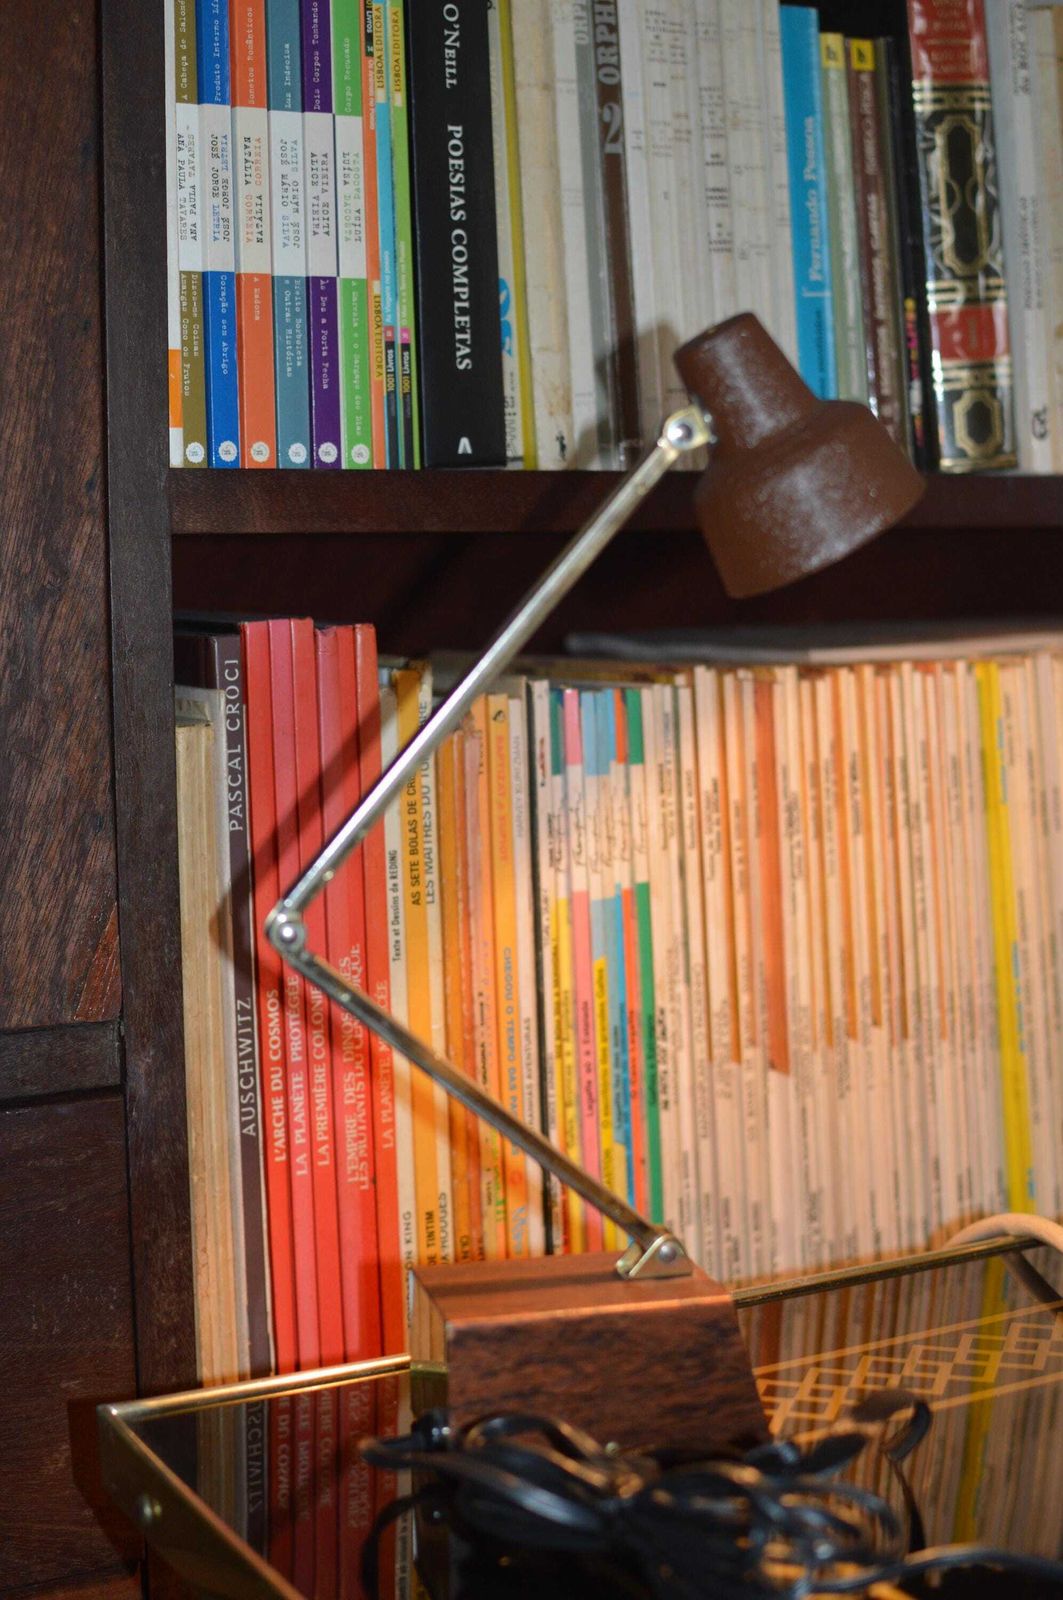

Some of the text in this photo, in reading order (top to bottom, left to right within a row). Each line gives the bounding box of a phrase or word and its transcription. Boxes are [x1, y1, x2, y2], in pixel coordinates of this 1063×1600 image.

[179, 37, 188, 51] de
[365, 10, 374, 33] Livros
[375, 6, 385, 89] LISBOA EDITORA
[392, 10, 402, 93] LISBOA EDITORA
[213, 19, 222, 103] Produto Interno
[594, 0, 623, 154] 2 ORPH
[177, 132, 188, 241] ANA PAULA TAVARES
[187, 133, 196, 178] TAVARES
[342, 151, 353, 186] LUÍSA
[446, 124, 467, 221] POESIAS
[189, 184, 197, 216] PAULA
[210, 133, 221, 242] JOSÉ JORGE LETRIA
[221, 134, 230, 242] JOSÉ JORGE LETRIA
[244, 135, 255, 243] NATÁLIA CORREIA
[253, 136, 264, 243] NATÁLIA CORREIA
[280, 138, 291, 249] JOSÉ MÁRIO SILVA
[291, 179, 301, 214] MÁRIO
[310, 151, 321, 237] ALICE VIEIRA
[321, 152, 330, 237] ALICE VIEIRA
[291, 221, 301, 249] JOSÉ
[219, 274, 229, 314] Coração
[451, 228, 473, 370] COMPLETAS
[181, 318, 191, 341] Como
[221, 340, 230, 375] Abrigo
[321, 329, 329, 357] Porta
[373, 294, 383, 378] LISBOA EDITORA
[385, 349, 395, 392] 1001 Livros
[402, 351, 411, 393] 1001 Livros
[224, 659, 243, 832] PASCAL CROCI
[407, 799, 417, 815] DE
[421, 785, 431, 806] DU
[408, 818, 419, 856] BOLAS
[409, 860, 420, 887] SETE
[411, 891, 421, 906] AS
[425, 879, 435, 905] LES
[388, 849, 401, 962] Texte et Dessins de REDING
[236, 997, 256, 1137] AUSCHWITZ
[266, 989, 286, 1162] L'ARCHE DU COSMOS
[285, 975, 308, 1175] LA PLANÈTE PROTÉGÉE
[312, 1062, 329, 1141] PREMIÈRE
[342, 1071, 360, 1183] L'EMPIRE DES
[378, 1057, 395, 1149] LA PLANÈTE
[316, 1145, 330, 1166] LA
[358, 1161, 370, 1191] LES
[402, 1210, 412, 1245] KING
[424, 1210, 436, 1249] TINTIM
